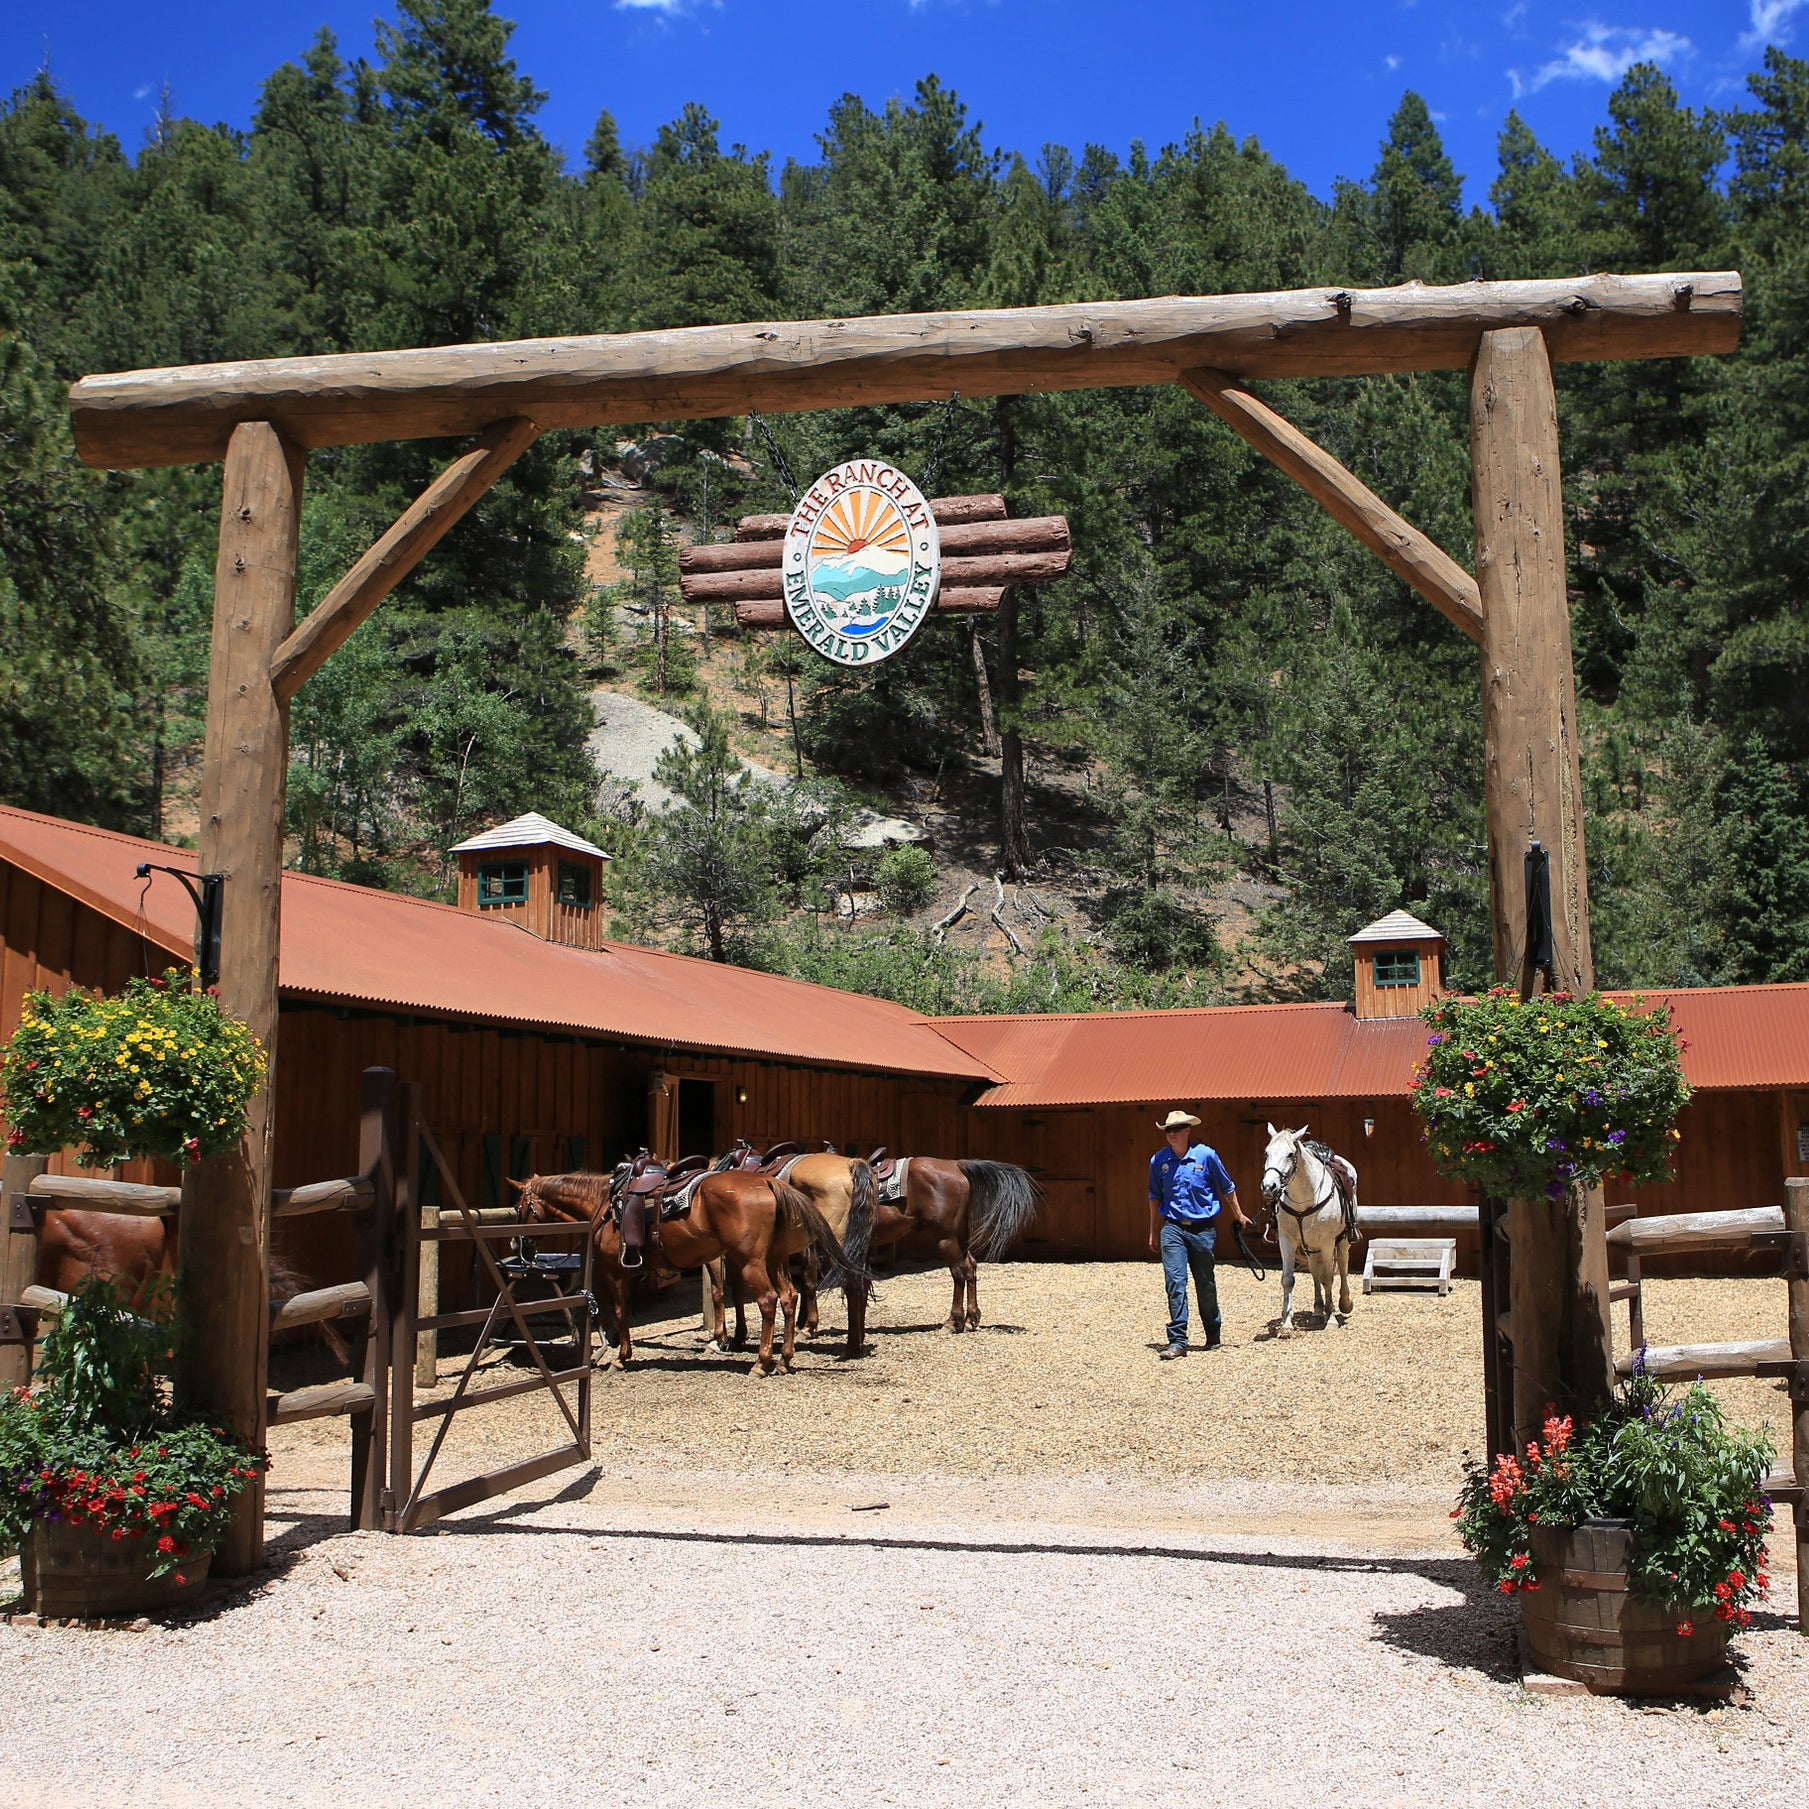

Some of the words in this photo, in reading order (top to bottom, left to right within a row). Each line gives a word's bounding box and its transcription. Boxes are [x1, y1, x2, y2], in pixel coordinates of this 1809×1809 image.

[790, 487, 829, 538] THE
[824, 463, 911, 501] RANCH
[901, 502, 930, 531] AT
[786, 570, 869, 661] EMERALD
[871, 561, 933, 652] VALLEY
